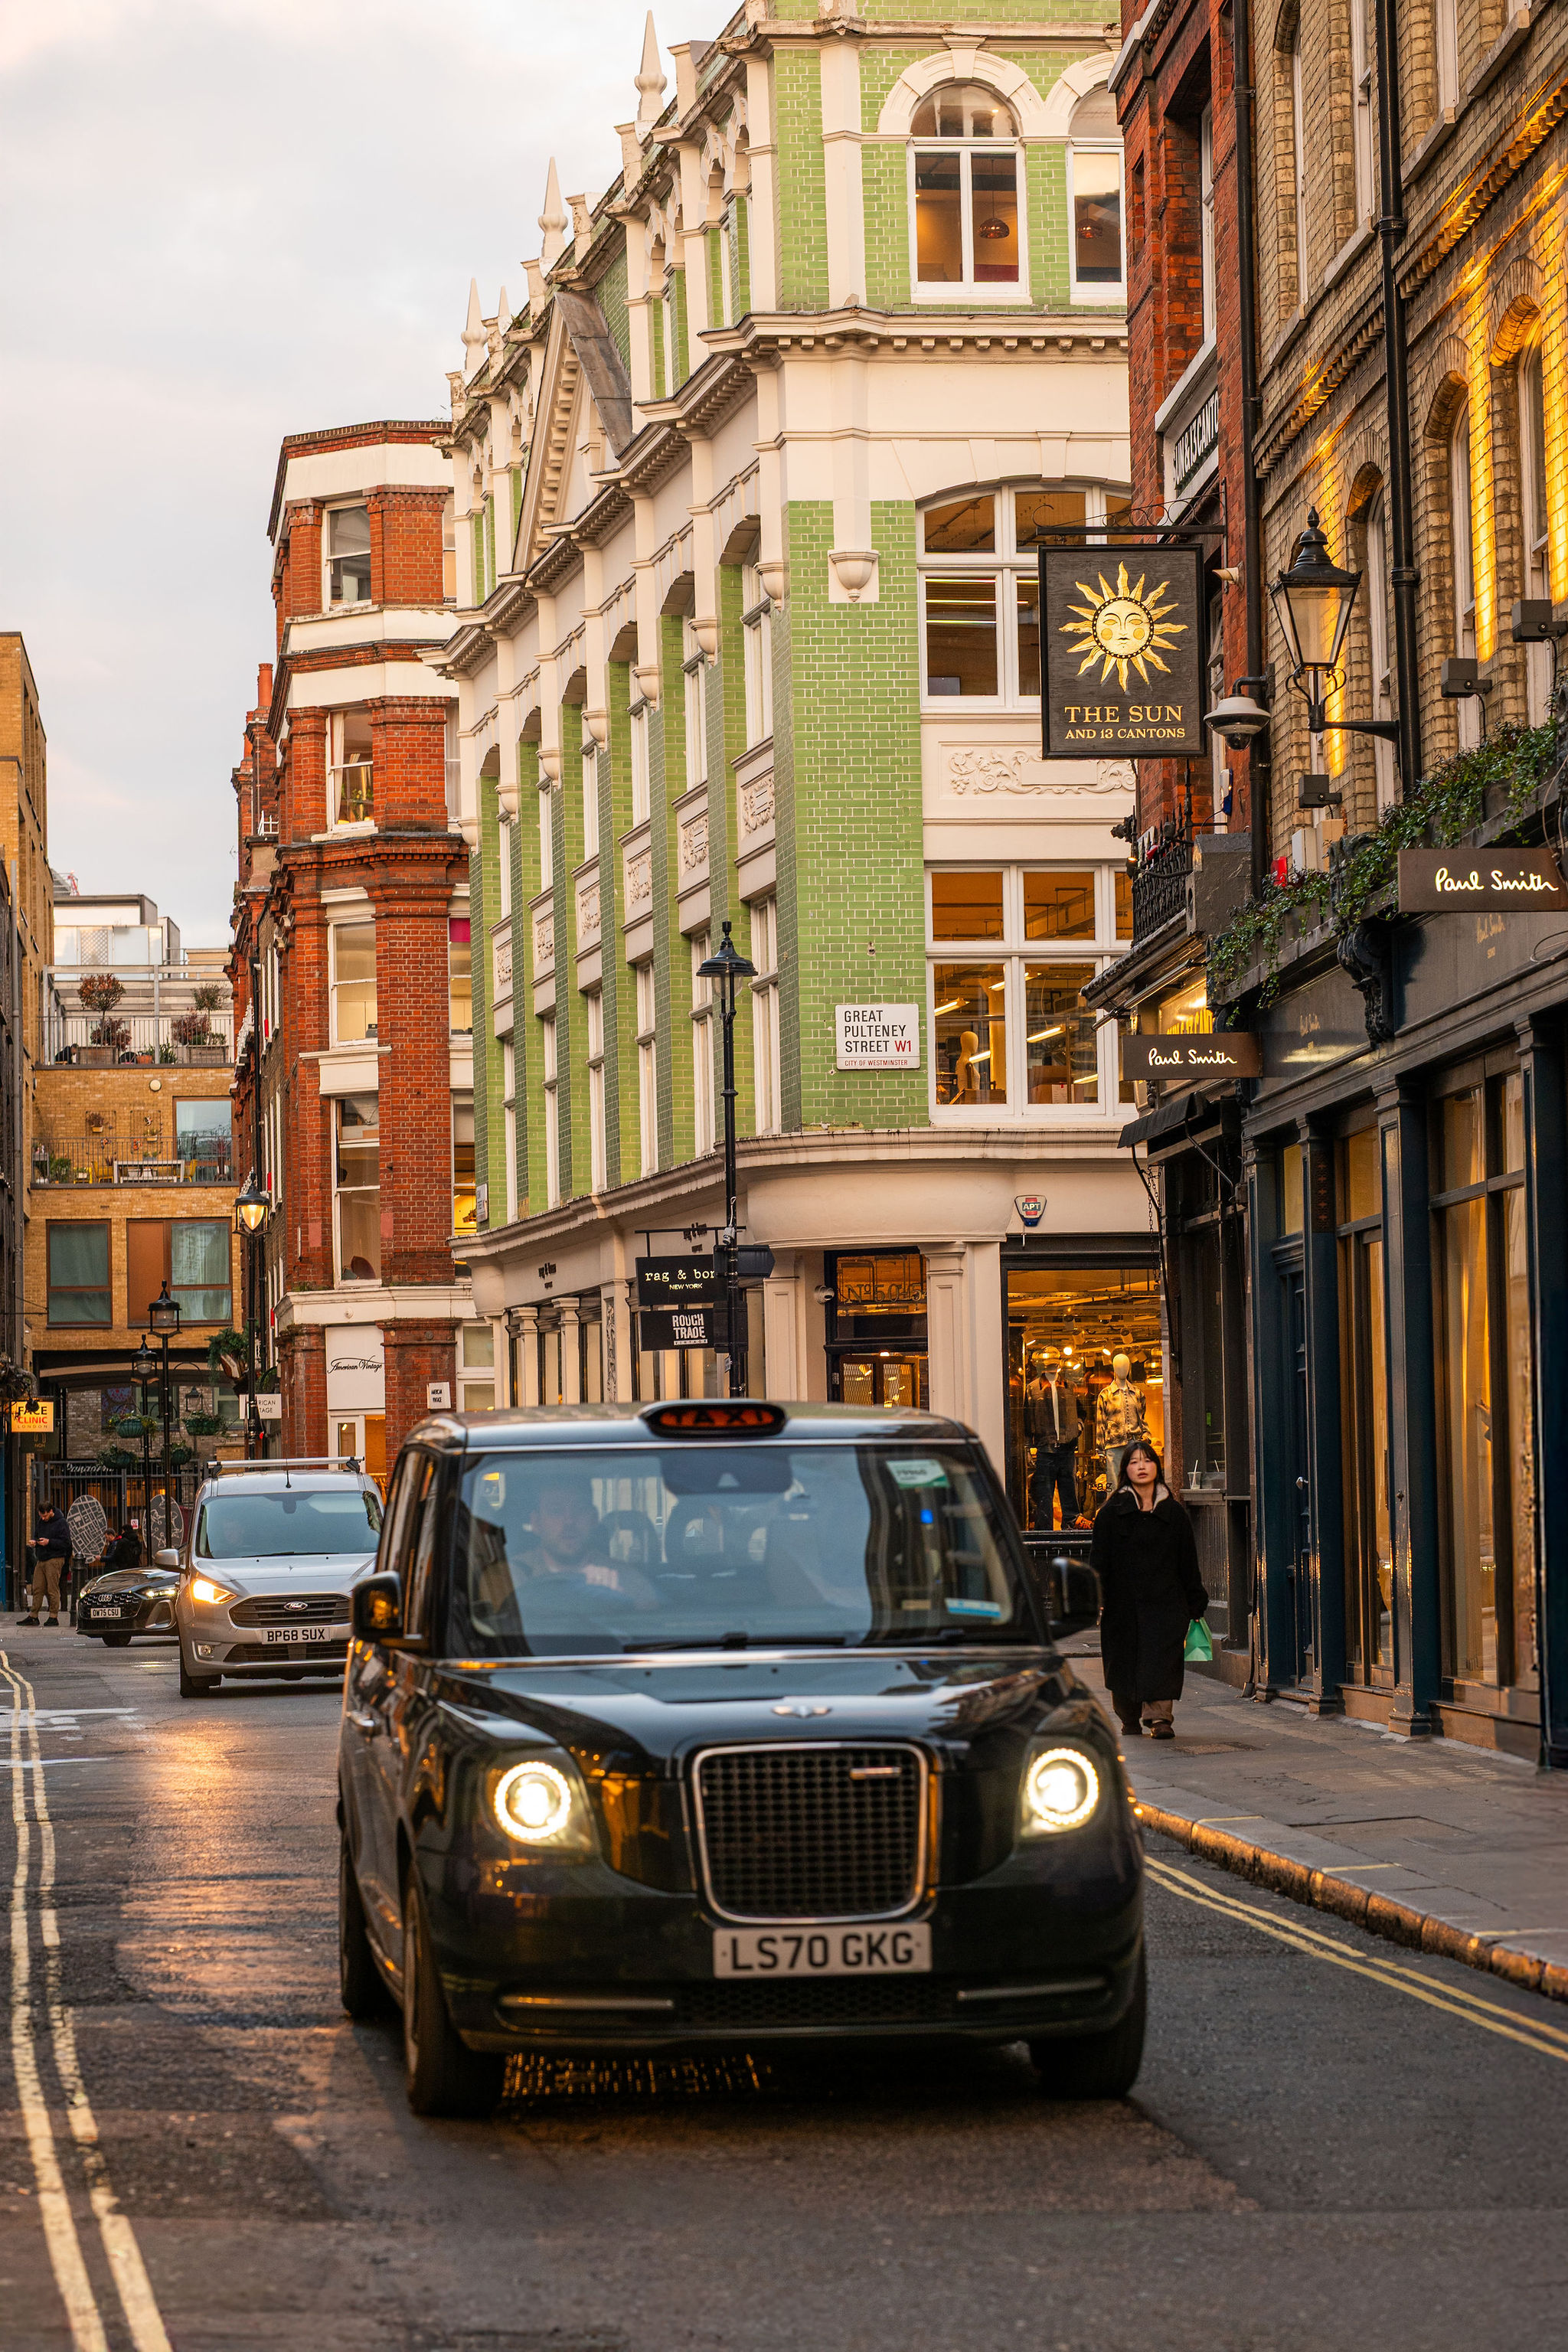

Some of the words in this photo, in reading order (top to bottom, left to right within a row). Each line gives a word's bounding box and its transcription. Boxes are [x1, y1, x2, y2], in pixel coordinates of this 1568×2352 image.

[1064, 706, 1119, 723] THE
[1129, 705, 1183, 723] SUN
[1064, 729, 1096, 740] AND
[1100, 728, 1113, 739] 13
[1117, 728, 1185, 739] CANTONS
[1435, 867, 1485, 892] Paul
[1491, 869, 1559, 892] Smith
[844, 1010, 884, 1022] GREAT
[844, 1024, 906, 1037] PULTENEY
[845, 1040, 890, 1052] STREET
[894, 1040, 912, 1052] W1
[1148, 1047, 1184, 1066] Paul
[1187, 1048, 1238, 1065] Smith
[645, 1272, 670, 1282] rag
[677, 1269, 687, 1280] &
[671, 1313, 704, 1327] ROUGH
[673, 1326, 706, 1340] TRADE
[327, 1357, 358, 1374] American
[358, 1354, 383, 1373] Vintage
[669, 1409, 764, 1426] TAXI
[1089, 1482, 1112, 1492] rag
[107, 1608, 119, 1616] CSU
[266, 1629, 299, 1642] BP68
[302, 1628, 325, 1640] SUX
[730, 1934, 829, 1971] LS70
[841, 1932, 913, 1967] GKG
